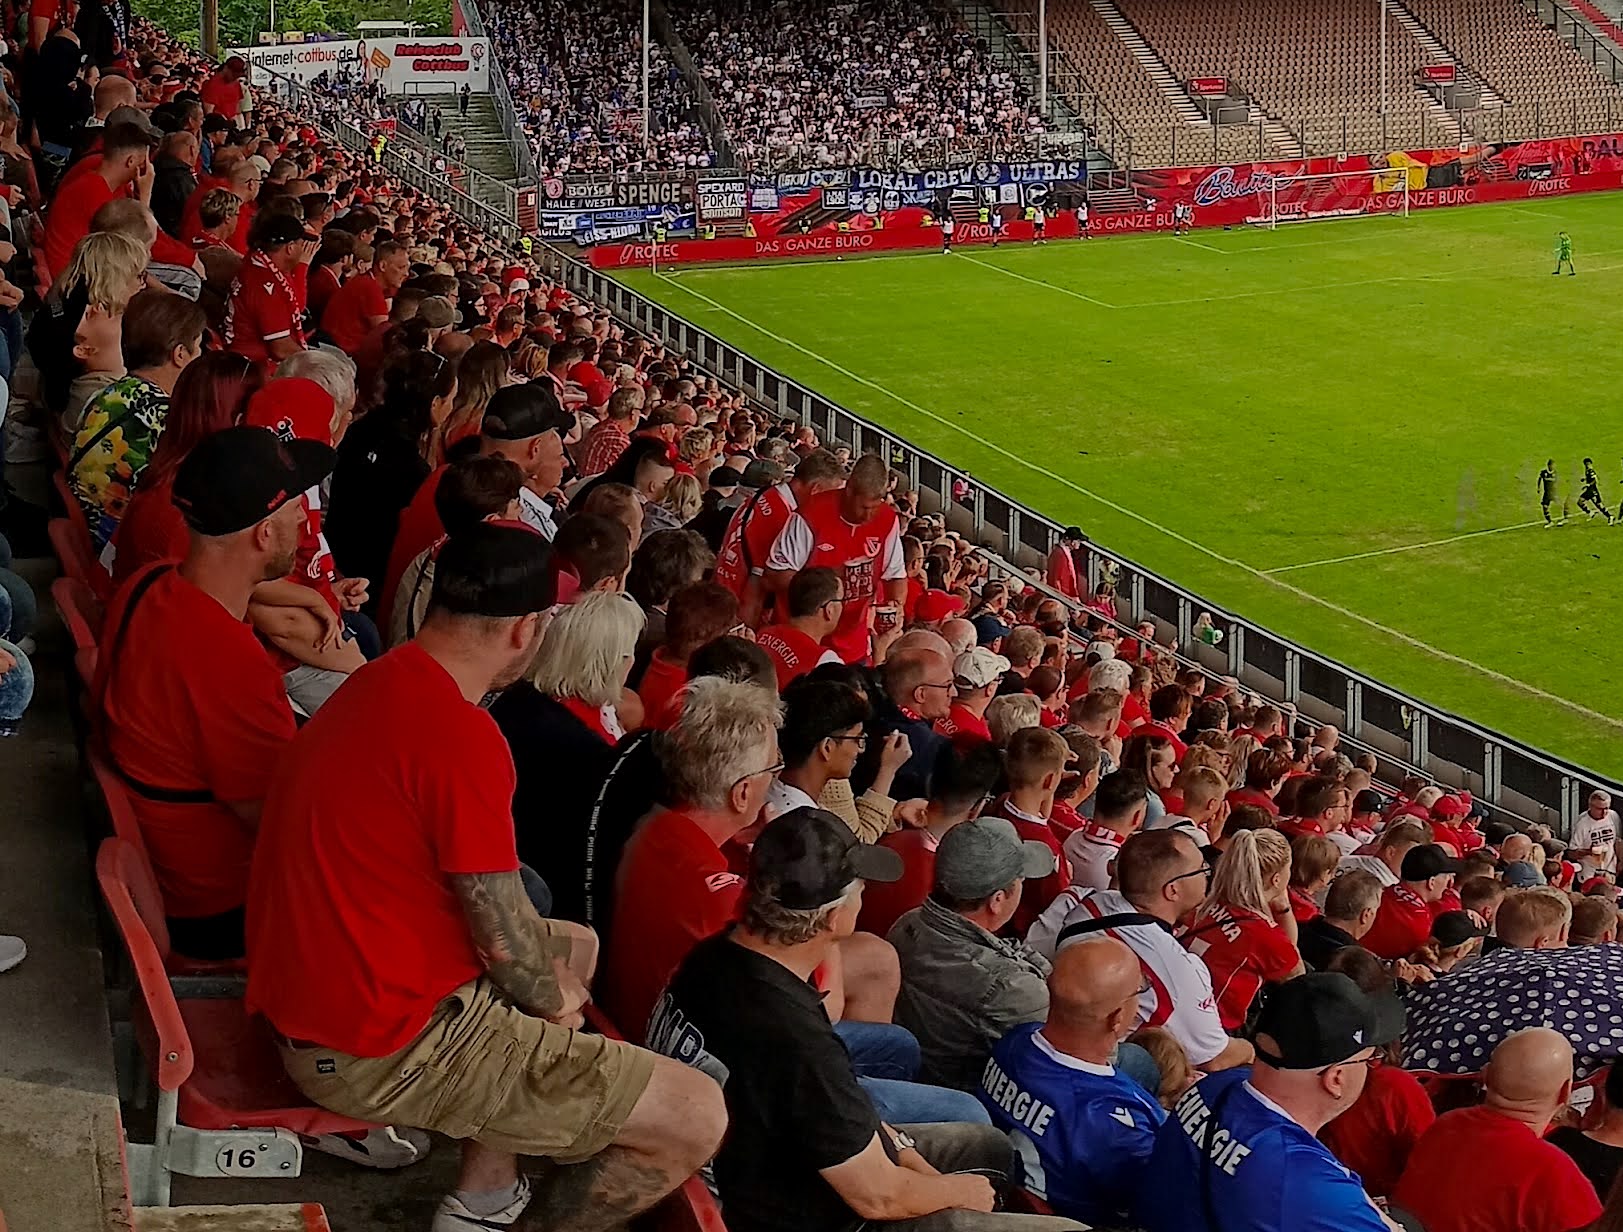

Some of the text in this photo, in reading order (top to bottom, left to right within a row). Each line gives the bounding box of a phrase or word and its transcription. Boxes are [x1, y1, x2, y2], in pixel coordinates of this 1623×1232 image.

[394, 43, 463, 57] Reiseclub
[412, 58, 470, 72] Cottbus
[859, 170, 919, 191] LOKAL
[923, 168, 972, 189] CREW
[1009, 161, 1080, 182] ULTRAS
[1539, 177, 1571, 191] ROTEC
[618, 183, 681, 205] SPENGE
[697, 182, 745, 194] SPEXARD
[545, 199, 576, 209] HALLE
[1356, 196, 1383, 211] DAS
[1385, 191, 1434, 208] GANZE
[1104, 214, 1152, 230] GANZE
[634, 243, 680, 260] ROTEC
[755, 240, 780, 253] DAS
[785, 237, 832, 251] GANZE
[758, 633, 800, 669] ENERGIE
[981, 1055, 1056, 1138] ENERGIE
[221, 1148, 257, 1170] 16
